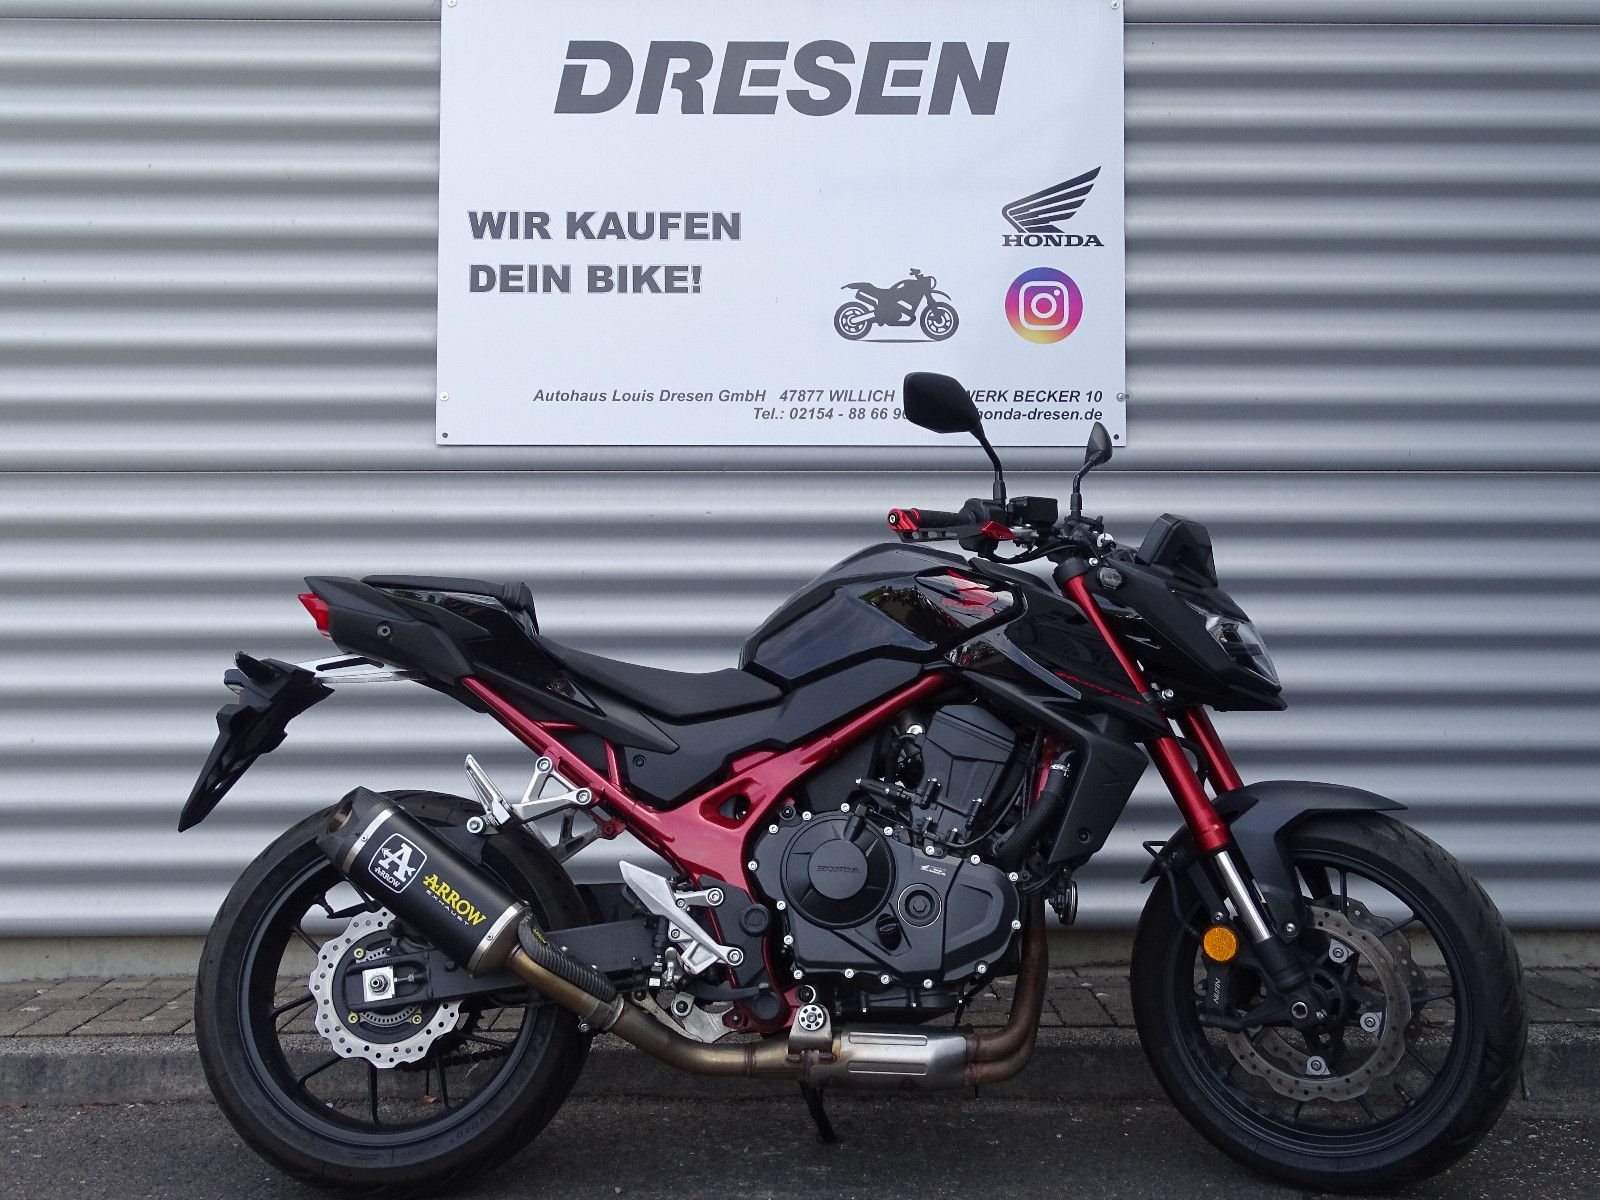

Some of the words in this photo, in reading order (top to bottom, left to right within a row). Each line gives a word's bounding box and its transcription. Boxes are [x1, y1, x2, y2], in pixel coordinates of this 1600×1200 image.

[554, 40, 1009, 116] DRESEN
[467, 210, 552, 240] WIR
[565, 210, 742, 241] KAUFEN
[1002, 234, 1104, 247] HONDA
[468, 264, 572, 295] DEIN
[586, 264, 703, 295] BIKE!
[533, 389, 608, 402] Autohaus
[612, 389, 654, 402] Louis
[659, 389, 714, 402] Dresen
[719, 389, 767, 402] GmbH
[779, 389, 824, 402] 47877
[829, 389, 896, 402] WILLICH
[1013, 389, 1081, 403] BECKER
[1085, 390, 1103, 403] 10
[753, 407, 785, 420] Tel.:
[790, 407, 834, 420] 02154
[848, 407, 866, 420] 88
[870, 407, 889, 420] 66
[374, 866, 401, 888] ARROW
[817, 865, 861, 874] HONDA
[423, 874, 486, 926] ARROW
